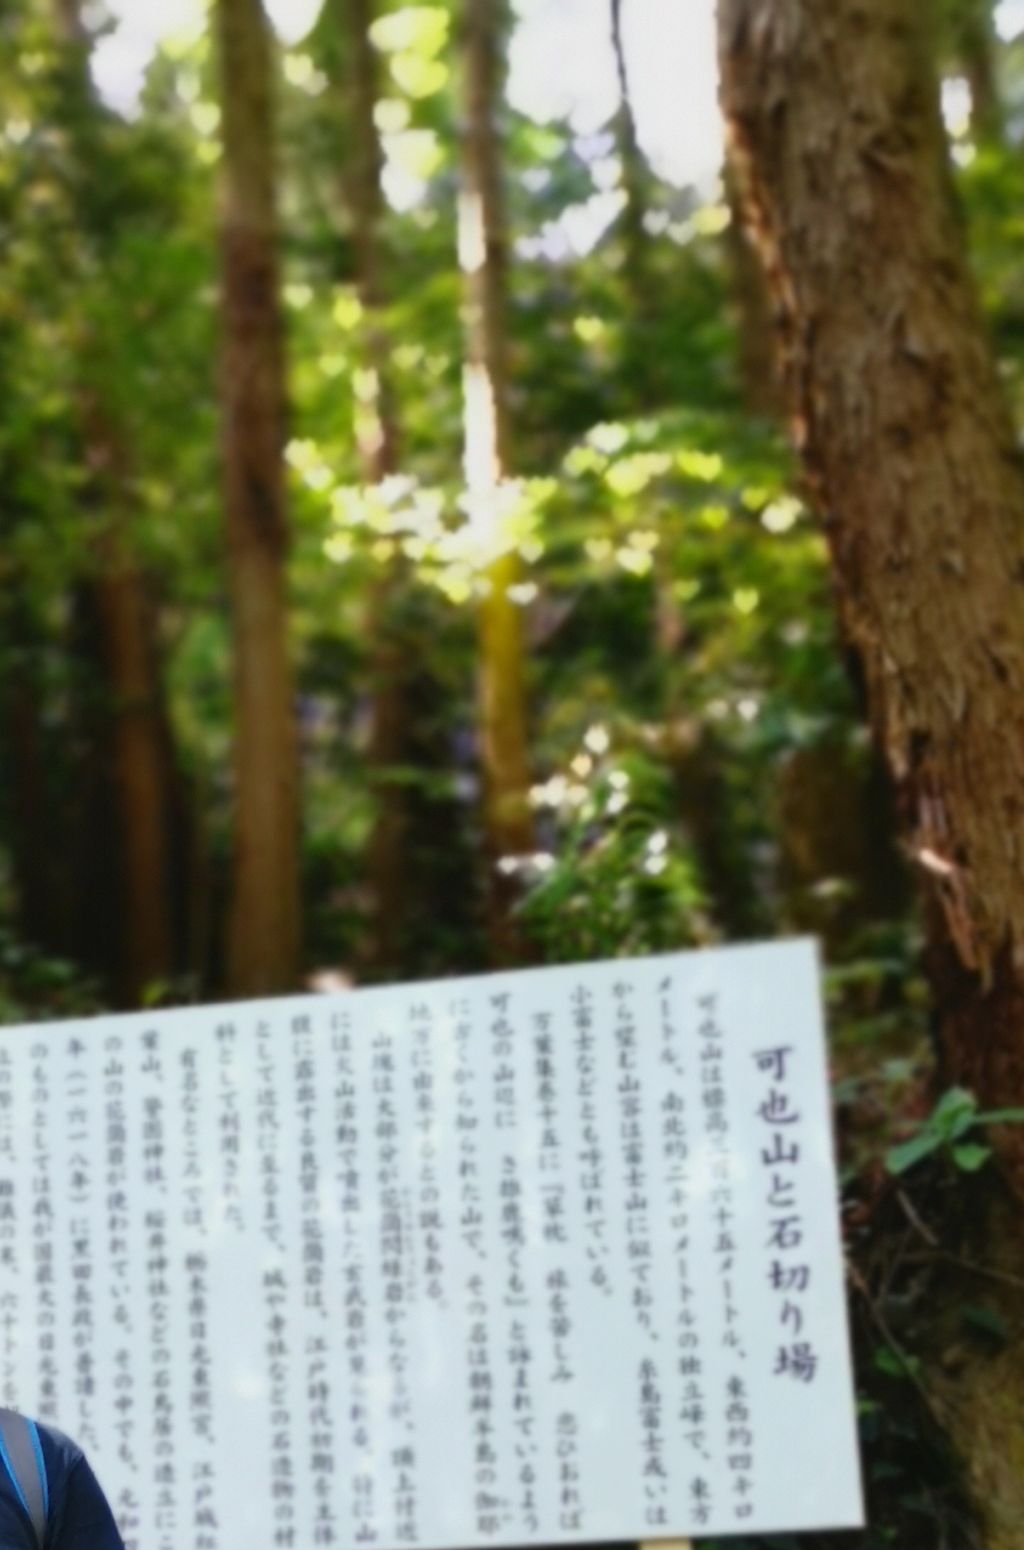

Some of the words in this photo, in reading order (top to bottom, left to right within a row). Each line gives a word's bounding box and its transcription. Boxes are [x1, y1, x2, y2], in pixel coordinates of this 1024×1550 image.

[570, 984, 613, 1296] 小富士などとも呼ばれている。
[751, 1044, 817, 1384] 可也山と石切り場
